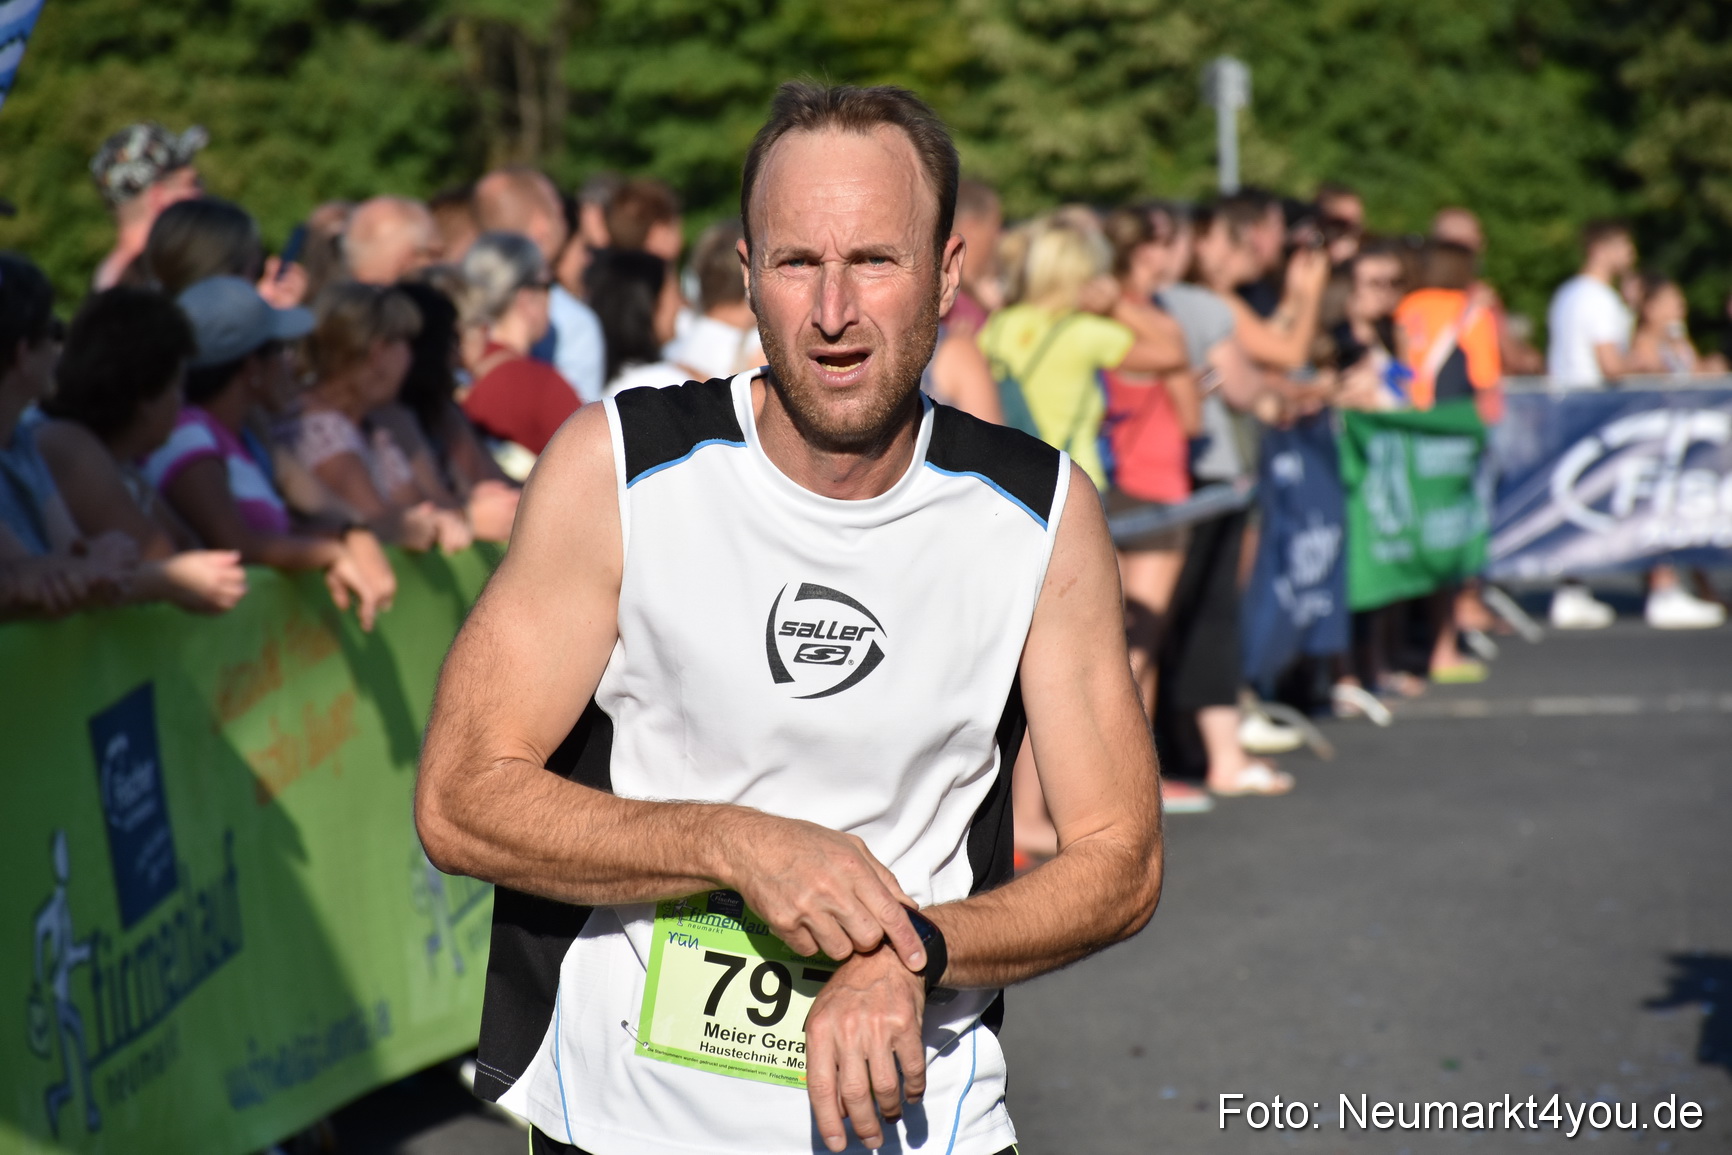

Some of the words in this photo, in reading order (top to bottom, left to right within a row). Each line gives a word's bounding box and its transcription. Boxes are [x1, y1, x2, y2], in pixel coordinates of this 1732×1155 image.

[778, 620, 876, 641] saller
[687, 923, 724, 934] neumarkt
[689, 906, 769, 936] firmenlau
[704, 1022, 756, 1045] Meier
[761, 1033, 806, 1054] Gera
[699, 1041, 778, 1065] Haustechnik
[699, 1059, 719, 1067] gedruckt
[769, 1072, 799, 1082] Frischmann
